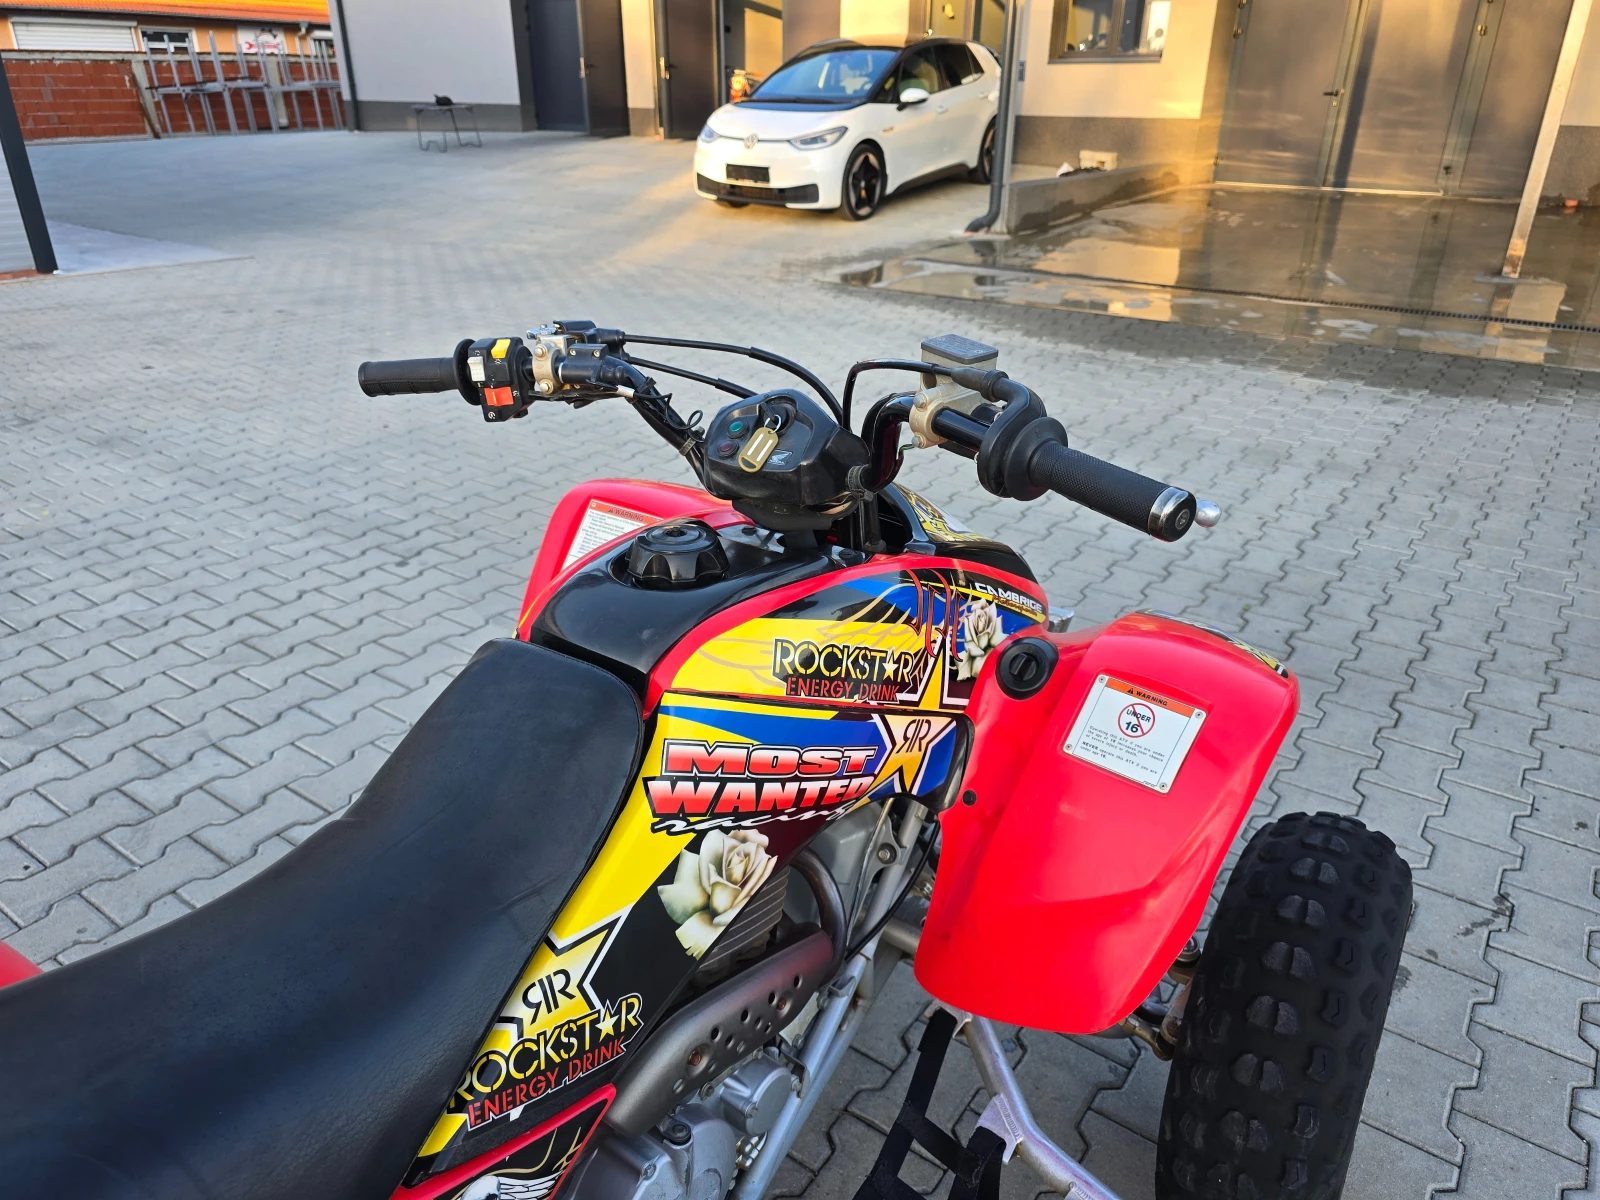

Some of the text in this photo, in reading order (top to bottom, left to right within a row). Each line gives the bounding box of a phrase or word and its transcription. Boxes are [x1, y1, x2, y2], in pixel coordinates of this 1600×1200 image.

[615, 509, 644, 521] WARNING
[974, 582, 1043, 613] CAMBRIGE
[786, 677, 901, 701] ENERGY DRINK
[1136, 690, 1168, 706] WARNING
[1125, 721, 1140, 733] 16
[1126, 708, 1152, 723] UNDER
[664, 740, 877, 776] MOST
[648, 776, 874, 813] WANTED
[467, 1035, 625, 1128] ENERGY DRINK
